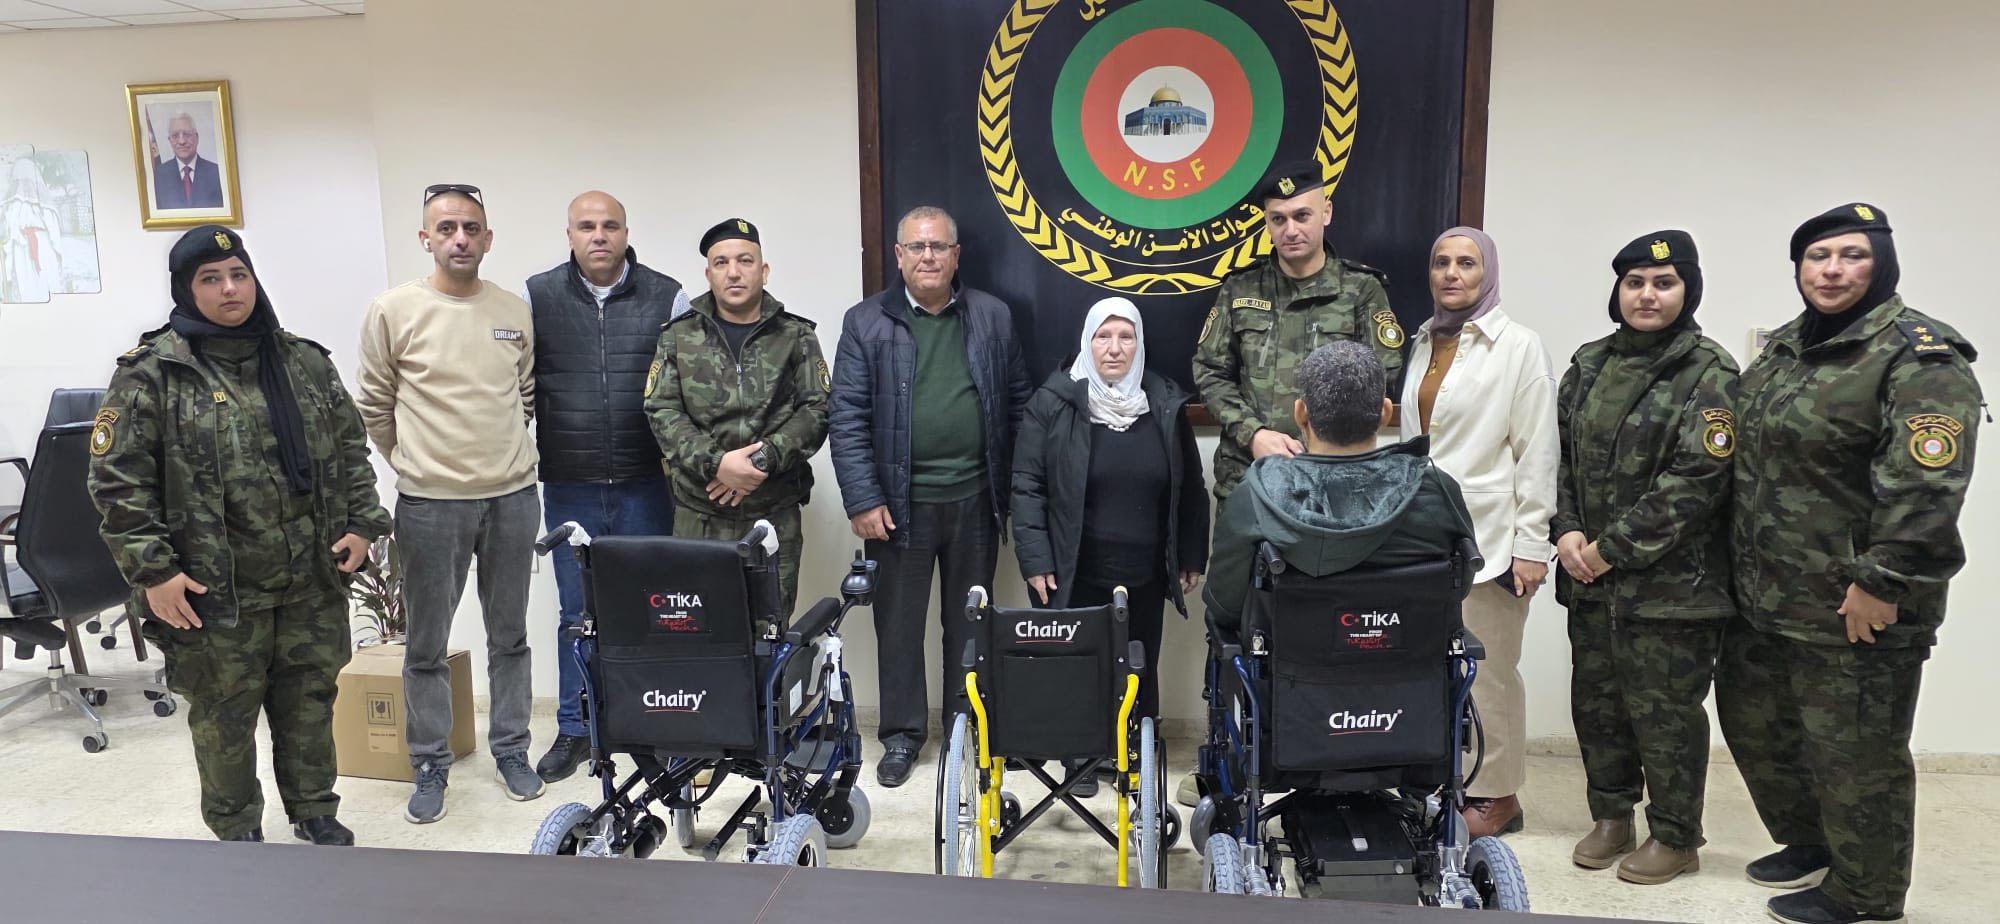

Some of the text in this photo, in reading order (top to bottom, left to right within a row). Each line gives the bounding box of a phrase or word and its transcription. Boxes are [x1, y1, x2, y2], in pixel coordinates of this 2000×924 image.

[1057, 203, 1264, 257] قوات الأمن الوطني
